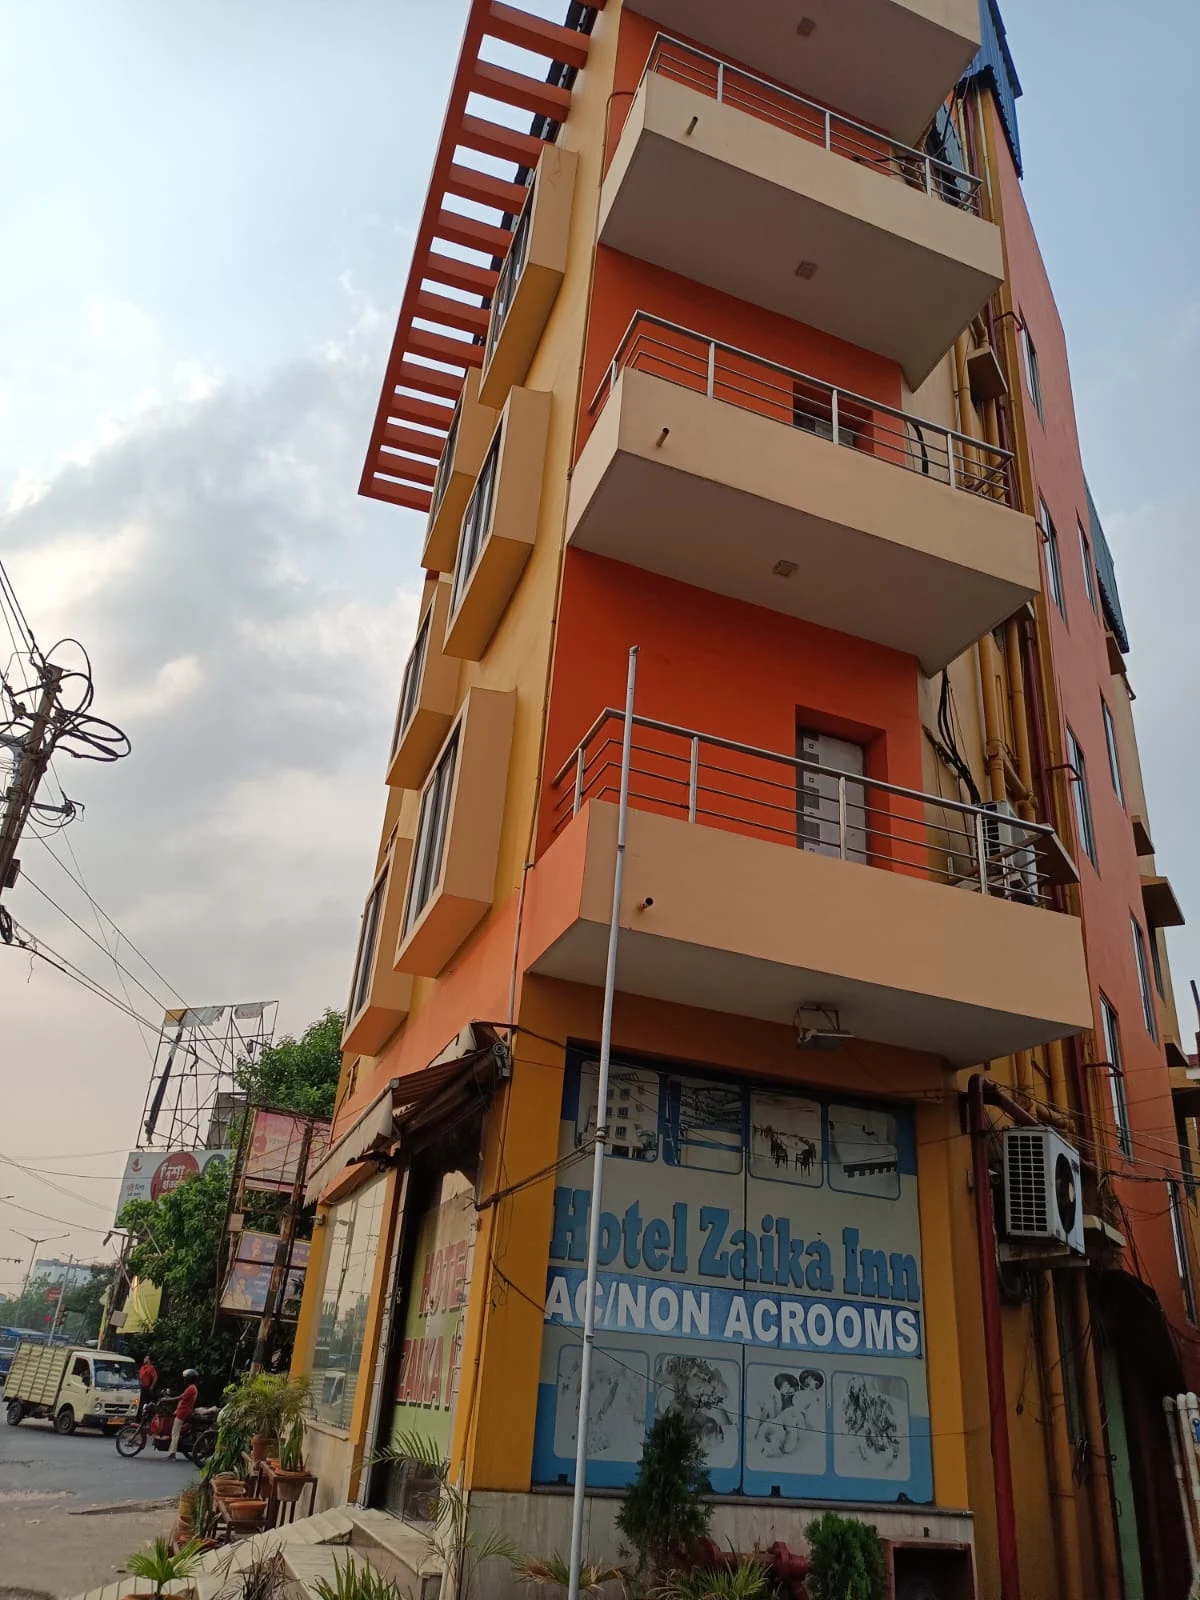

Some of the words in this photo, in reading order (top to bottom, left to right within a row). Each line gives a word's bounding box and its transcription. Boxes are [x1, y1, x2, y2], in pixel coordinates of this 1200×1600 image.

[549, 1186, 689, 1273] Hotel
[699, 1205, 834, 1294] Zaika
[842, 1227, 920, 1301] Inn
[545, 1276, 710, 1336] AC/NON
[395, 1336, 444, 1410] ZAIKA
